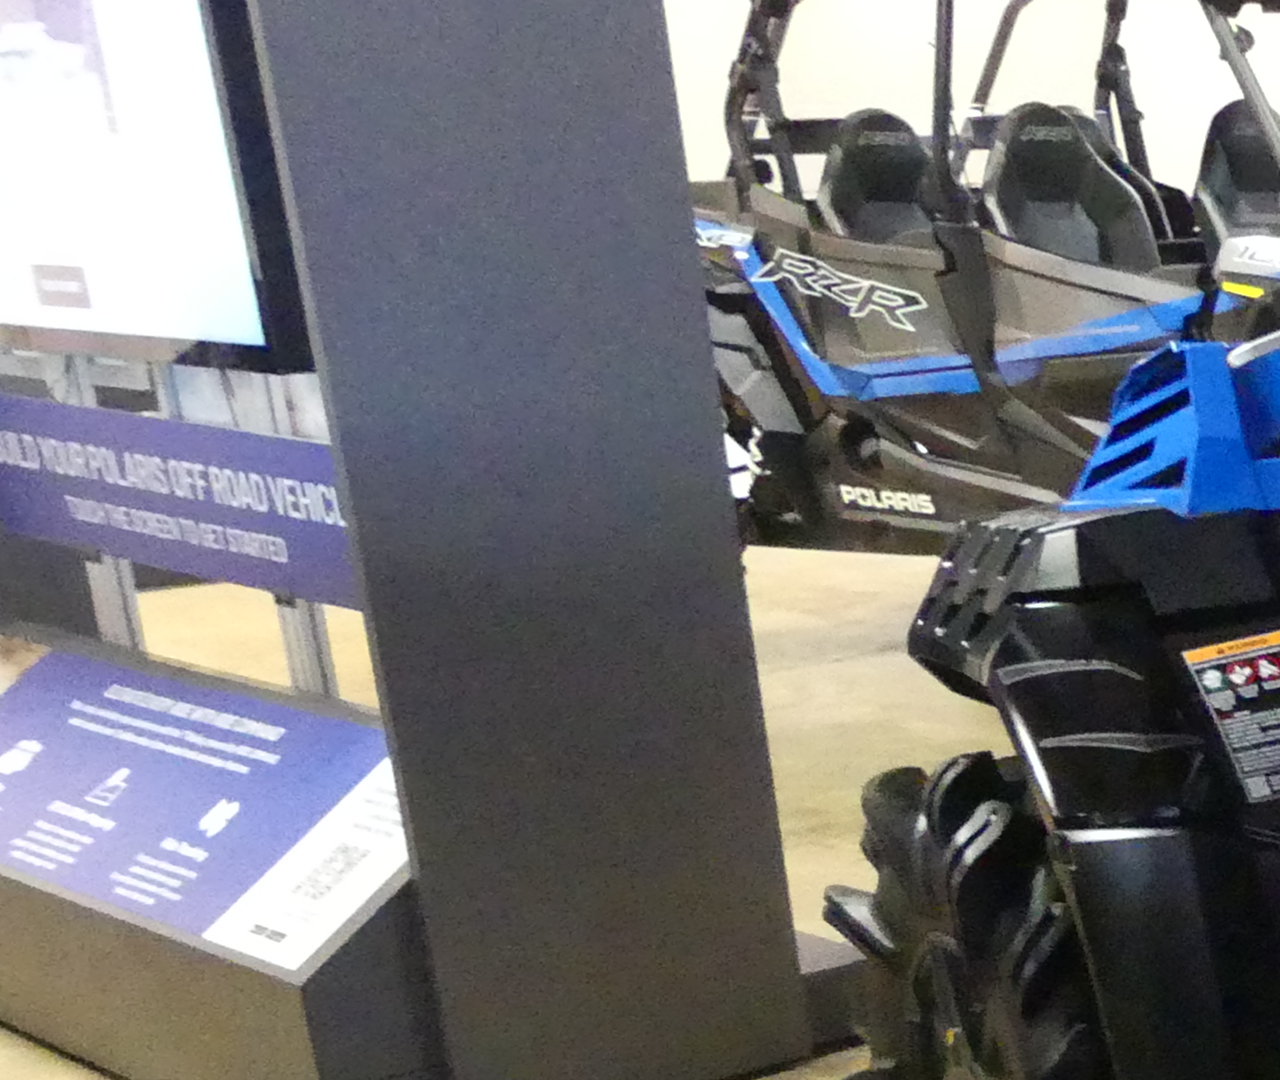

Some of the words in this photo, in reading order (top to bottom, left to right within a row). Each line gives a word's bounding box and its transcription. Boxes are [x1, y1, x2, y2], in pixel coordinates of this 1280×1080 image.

[751, 247, 928, 332] RZR
[83, 444, 170, 494] POLARIS
[167, 459, 206, 500] OFF
[207, 465, 268, 513] ROAD
[840, 484, 936, 515] POLARIS
